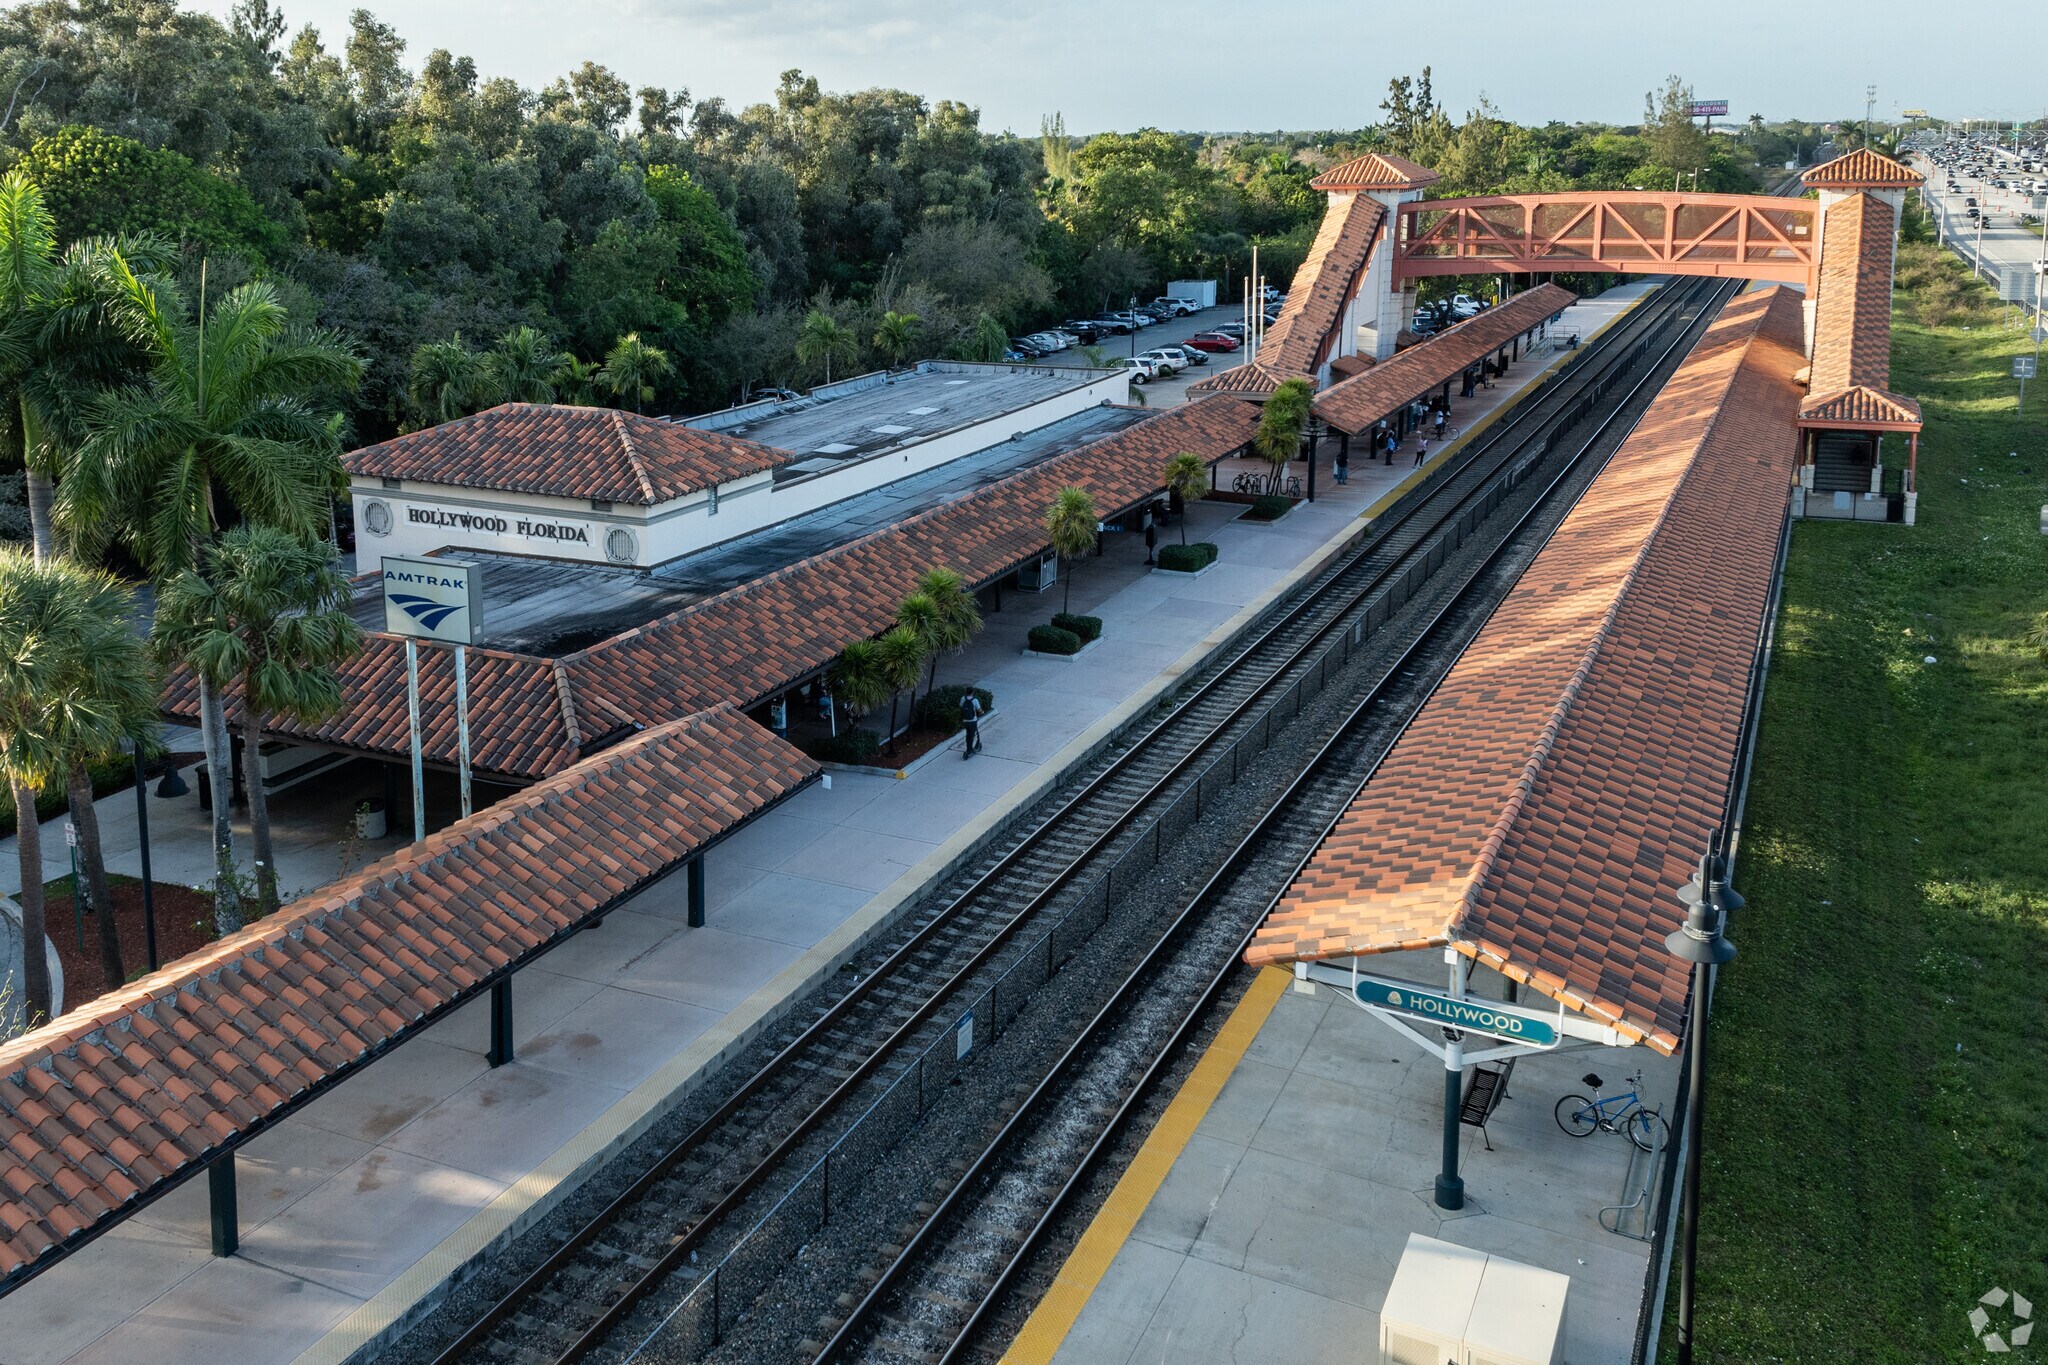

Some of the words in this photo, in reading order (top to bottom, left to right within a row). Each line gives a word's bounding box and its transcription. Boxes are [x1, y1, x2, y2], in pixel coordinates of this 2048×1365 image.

[408, 508, 507, 533] HOLLYWOOD
[516, 520, 588, 542] FLORIDA
[384, 571, 465, 590] AMTRAK
[1410, 995, 1523, 1033] HOLLYWOOD
